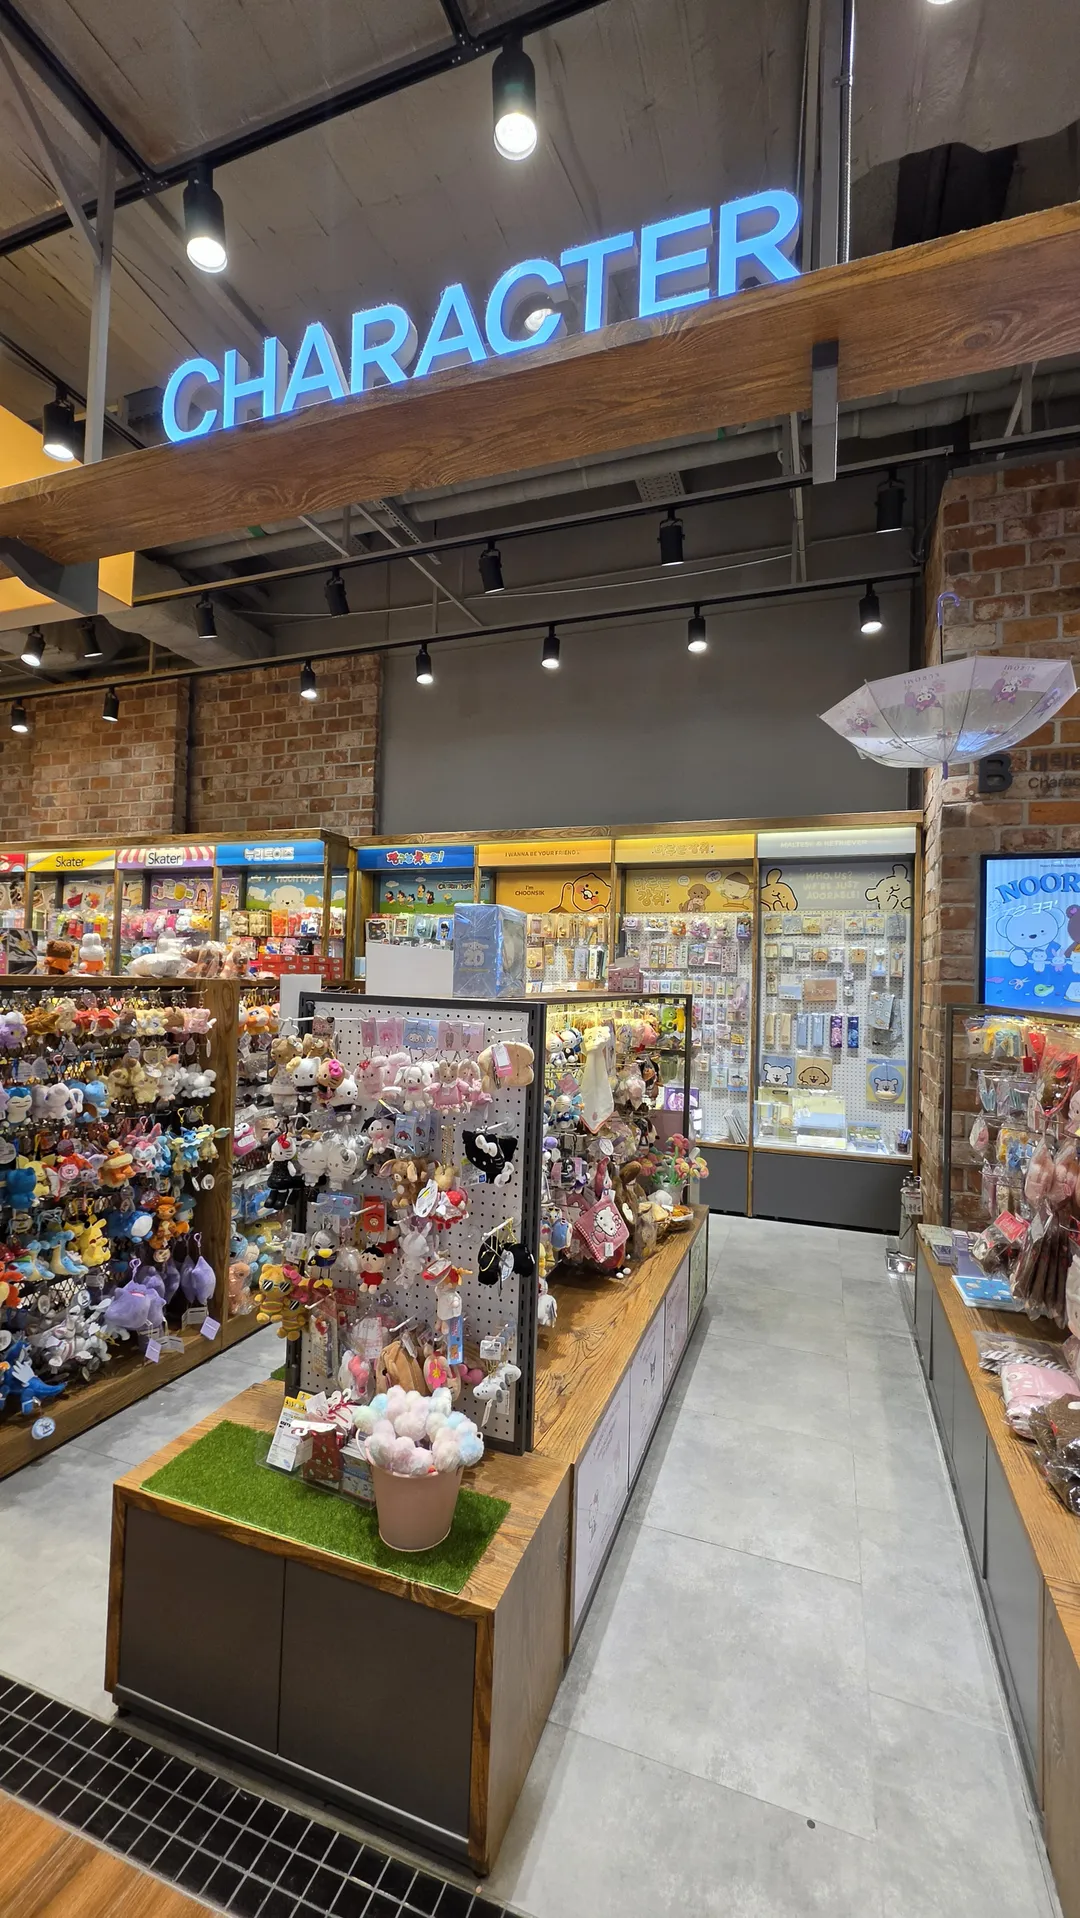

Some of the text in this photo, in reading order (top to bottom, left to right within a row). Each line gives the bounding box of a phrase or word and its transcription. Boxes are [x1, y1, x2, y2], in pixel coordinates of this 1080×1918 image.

[161, 189, 801, 443] CHARACTER
[978, 754, 1013, 793] B
[55, 855, 85, 868] Skater
[148, 851, 181, 866] Skater
[835, 881, 859, 891] JUST
